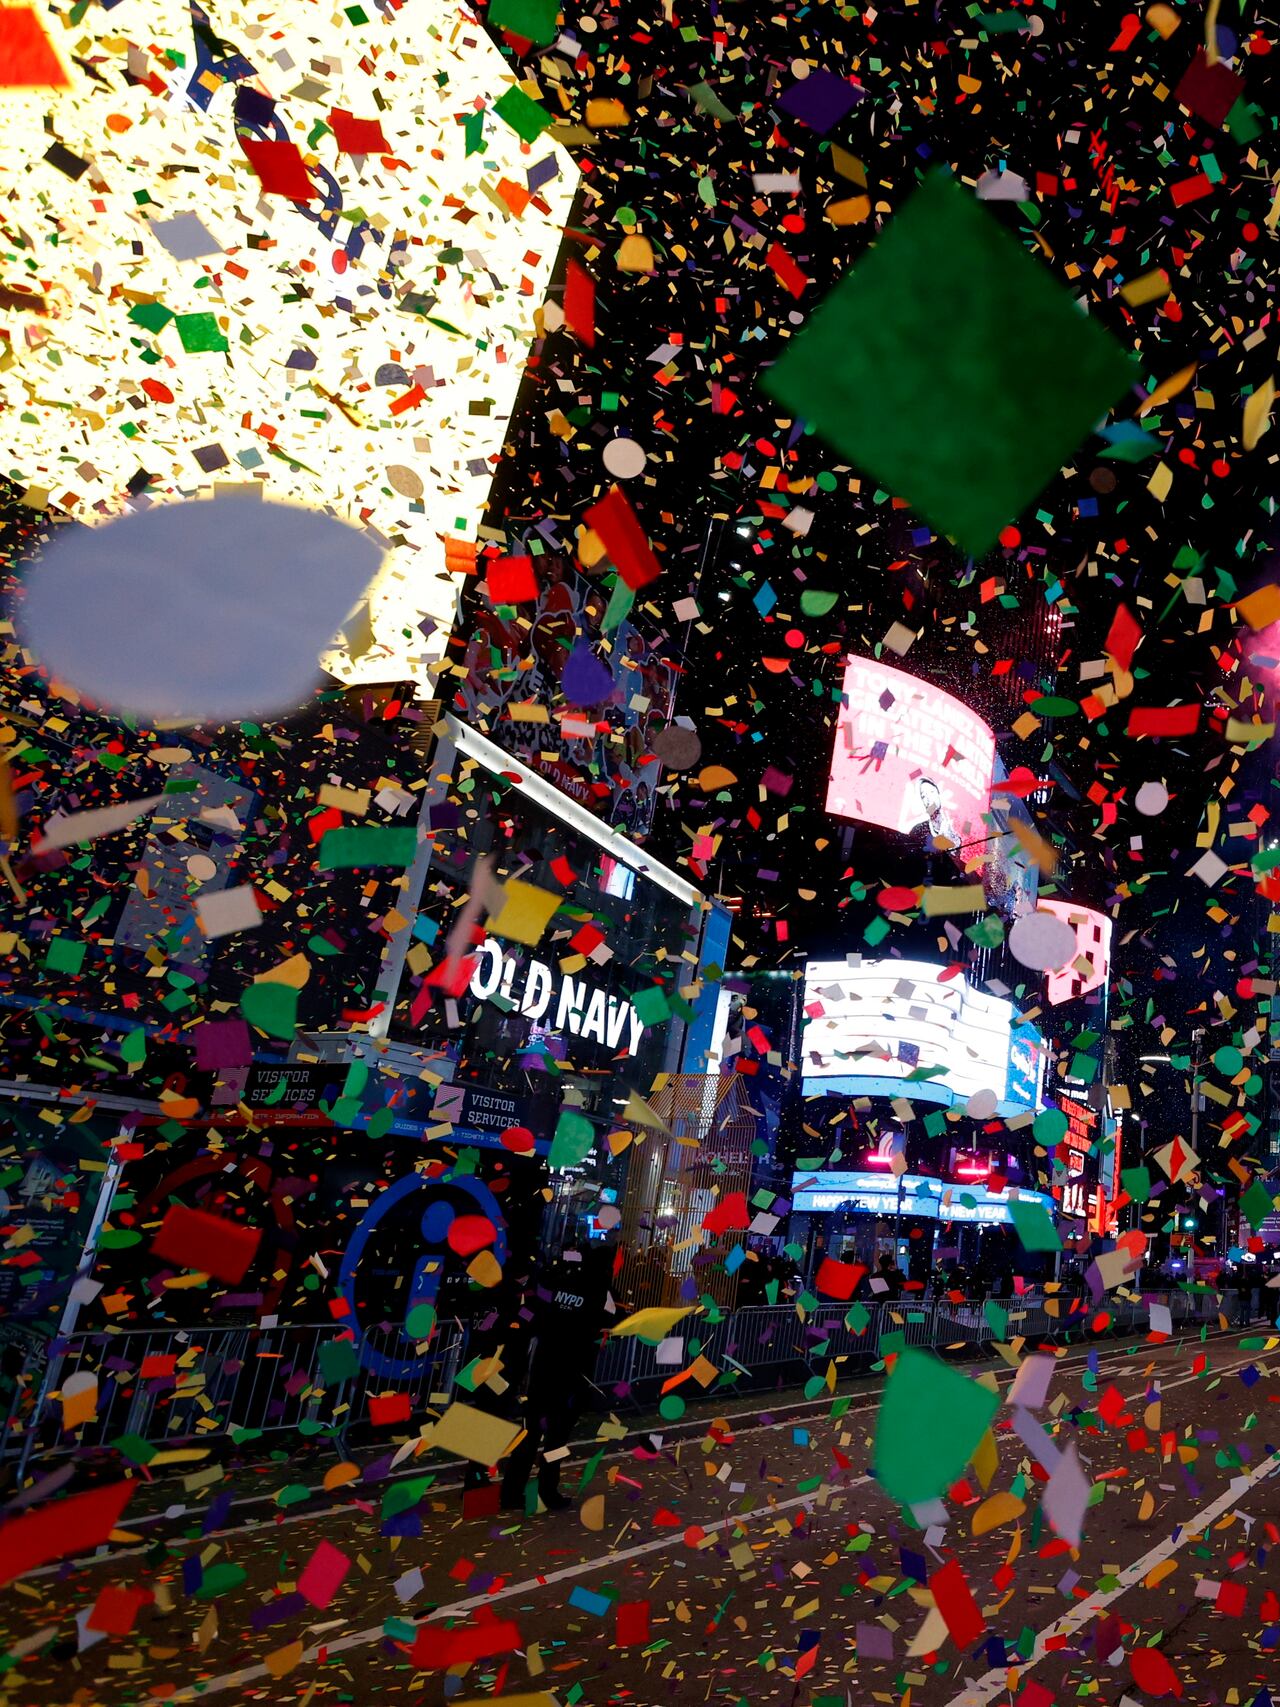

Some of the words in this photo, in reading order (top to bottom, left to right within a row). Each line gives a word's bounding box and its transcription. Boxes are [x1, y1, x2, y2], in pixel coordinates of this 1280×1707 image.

[470, 938, 554, 1020] OLD
[555, 973, 645, 1057] NAVY
[257, 1070, 309, 1083] VISITOR
[471, 1094, 515, 1112] VISITOR
[467, 1111, 521, 1129] SERVICES
[554, 1290, 585, 1308] NYPD
